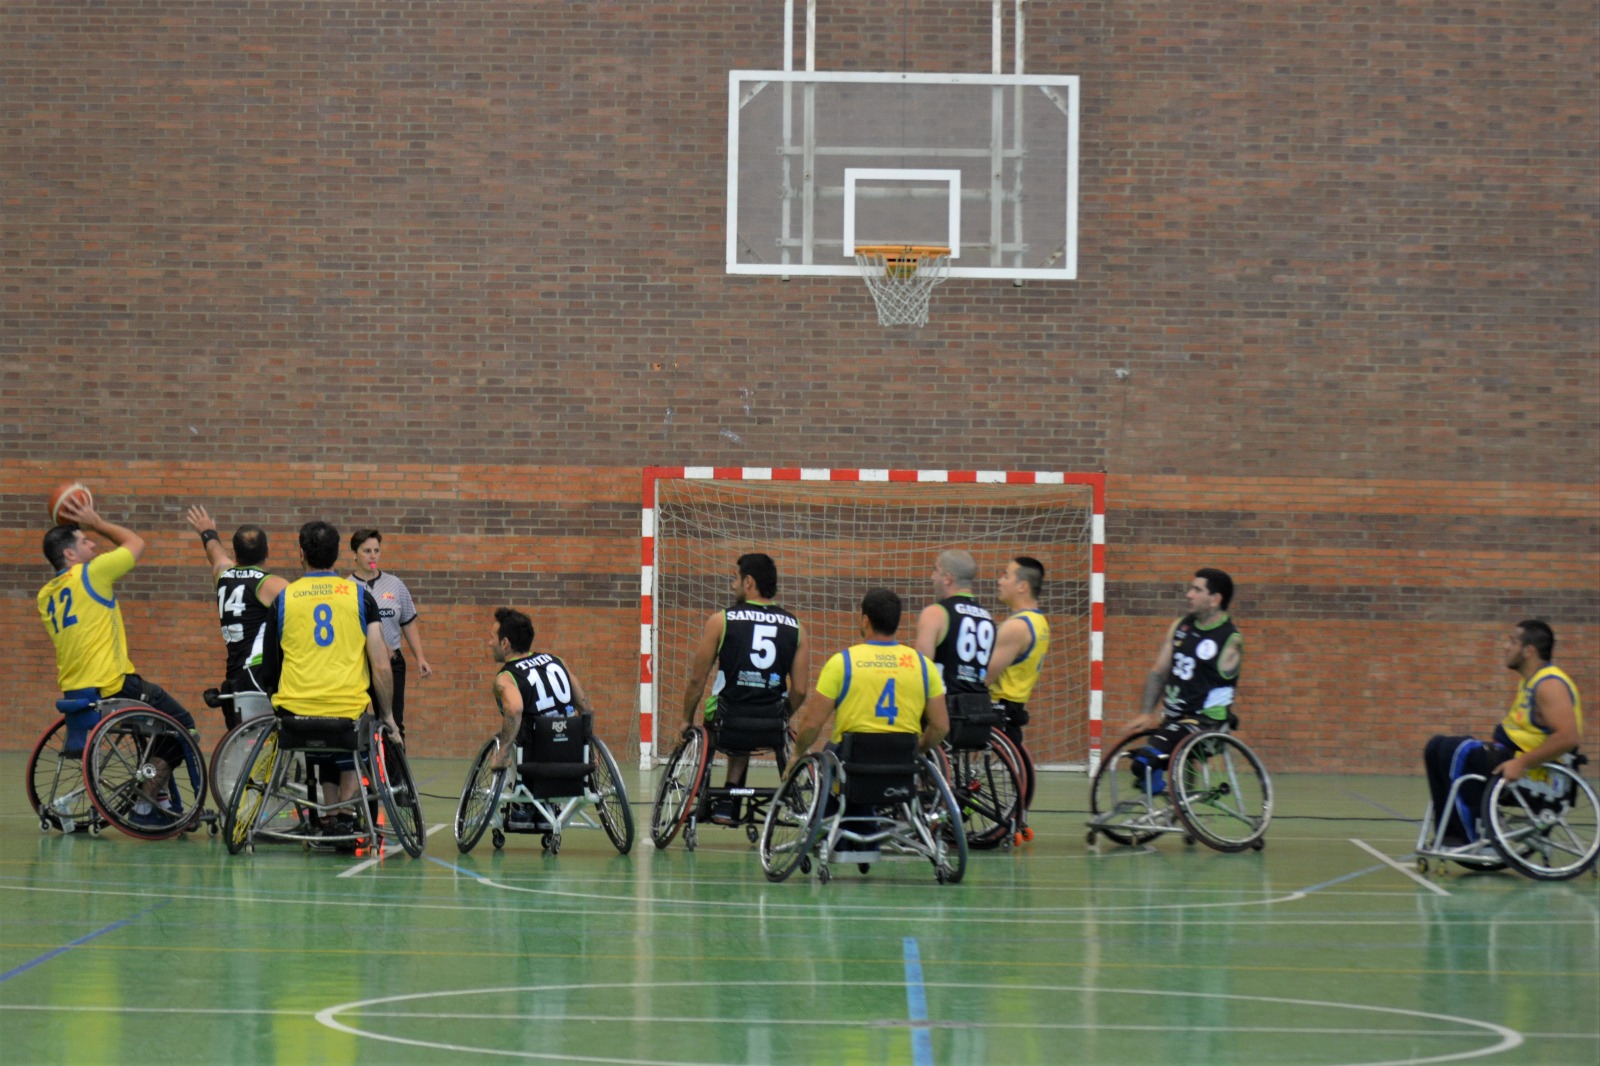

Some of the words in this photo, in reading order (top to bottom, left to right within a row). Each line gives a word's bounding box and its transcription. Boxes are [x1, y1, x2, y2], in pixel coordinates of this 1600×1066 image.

[46, 586, 78, 634] 12
[217, 584, 246, 619] 14
[293, 589, 333, 598] Canarias
[313, 603, 335, 647] 8
[726, 610, 799, 629] SANDOVAL
[956, 616, 995, 666] 69
[749, 624, 778, 670] 5
[856, 660, 898, 668] Canarias
[1172, 652, 1196, 681] 33
[526, 662, 572, 712] 10
[875, 677, 899, 726] 4
